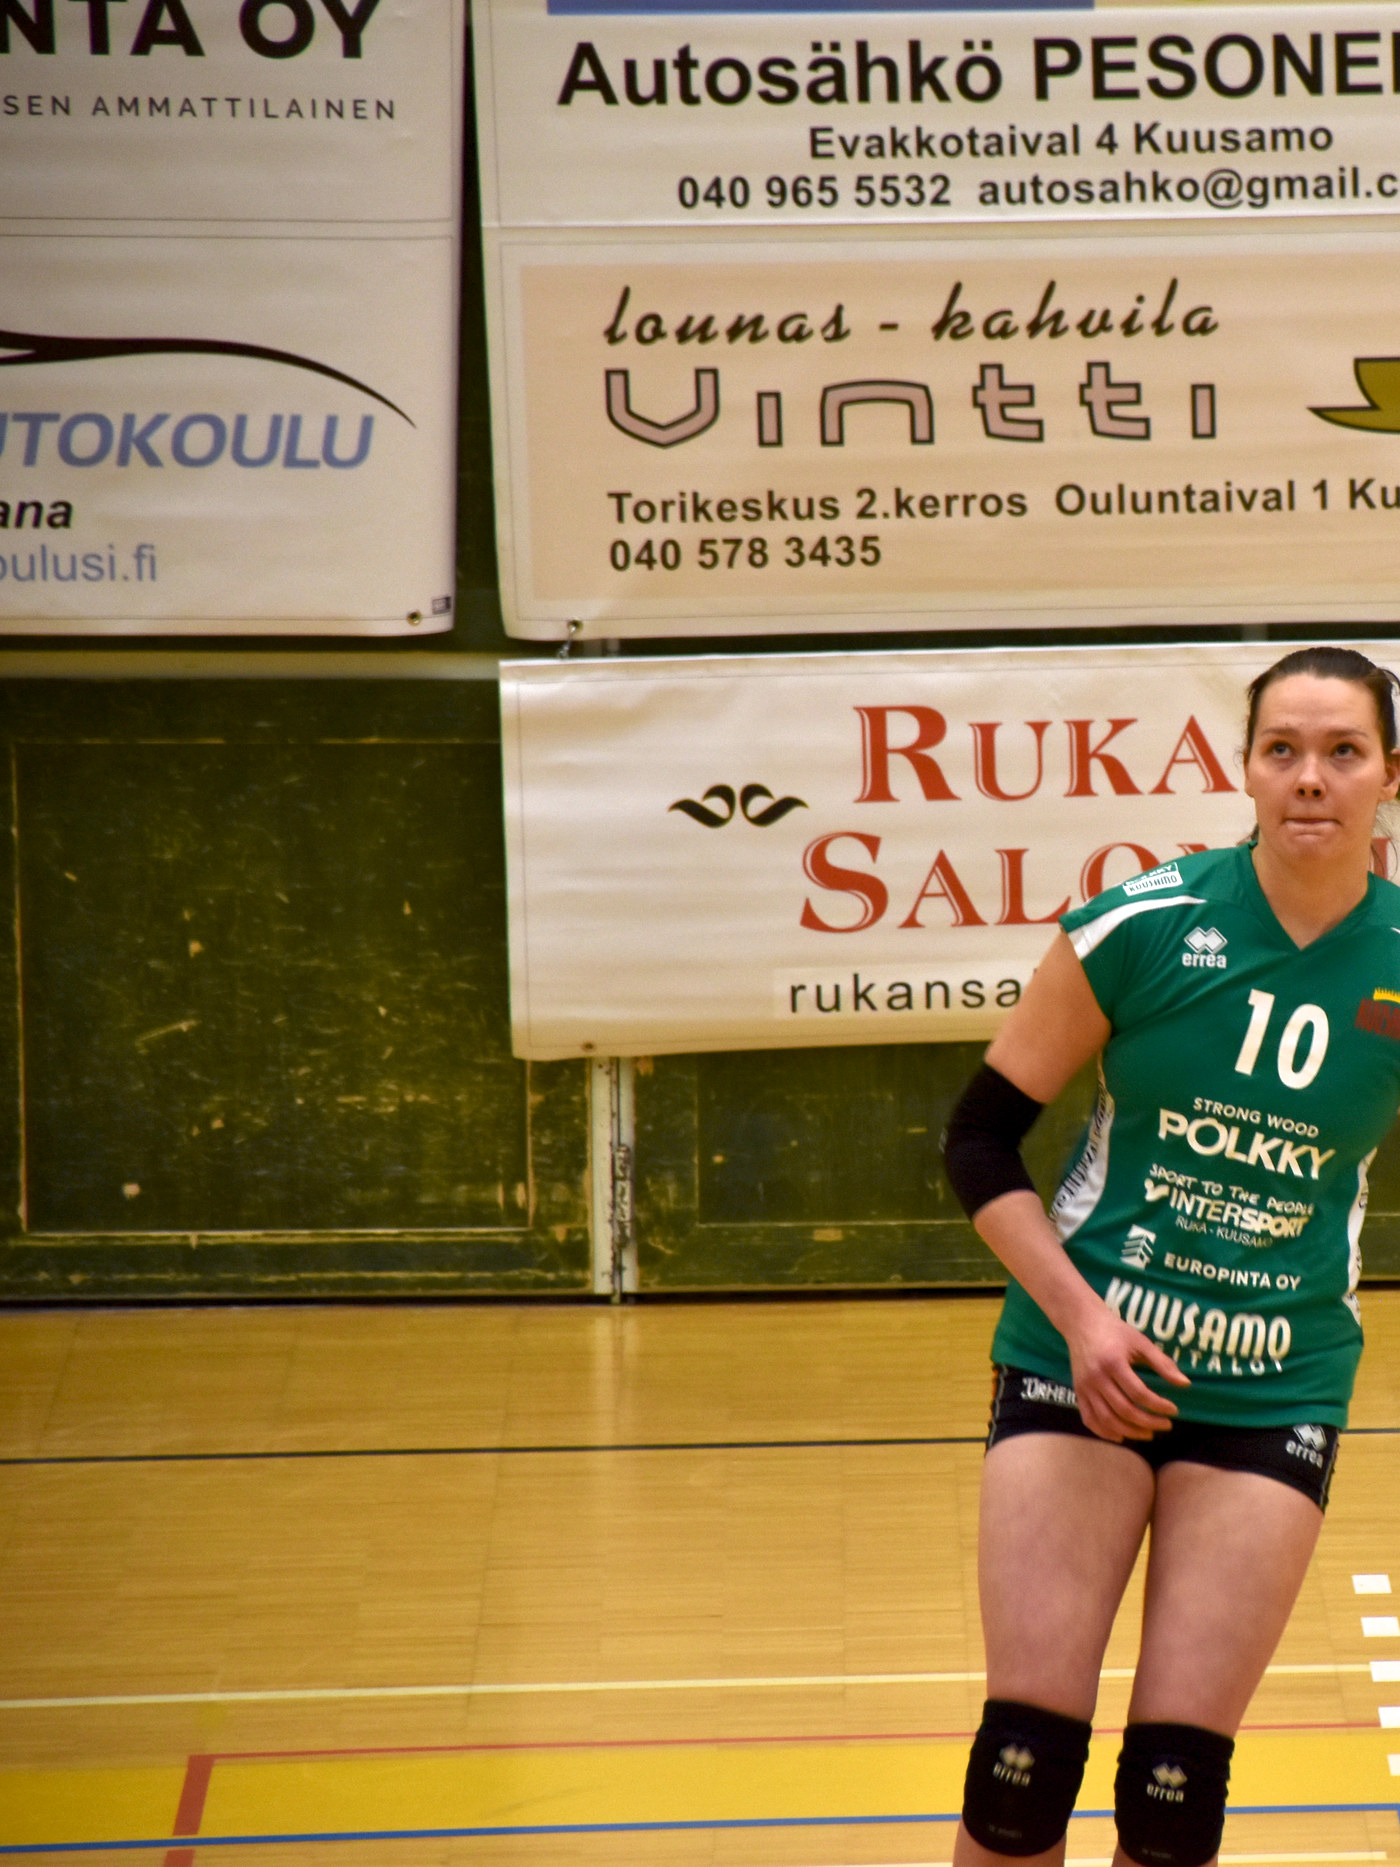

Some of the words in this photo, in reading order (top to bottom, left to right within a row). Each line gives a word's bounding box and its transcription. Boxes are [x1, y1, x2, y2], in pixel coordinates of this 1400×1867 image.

[239, 0, 379, 59] OY
[558, 39, 1003, 105] Autosähkö
[92, 97, 396, 119] AMMATTILAINEN
[810, 125, 1080, 159] Evakkotaival
[1096, 124, 1118, 154] 4
[1134, 122, 1333, 155] Kuusamo
[678, 177, 750, 208] 040
[766, 176, 839, 207] 965
[855, 175, 951, 206] 5532
[604, 286, 850, 345] lounas
[933, 280, 1218, 341] kahvila
[0, 412, 374, 469] TOKOULU
[607, 490, 840, 523] Torikeskus
[856, 487, 1028, 519] 2.kerros
[1055, 481, 1296, 515] Ouluntaival
[1313, 480, 1329, 509] 1
[611, 539, 681, 571] 040
[698, 538, 769, 569] 578
[784, 536, 881, 567] 3435
[1235, 988, 1329, 1090] 10
[1193, 1097, 1262, 1125] STRONG
[1267, 1113, 1320, 1138] WOOD
[1150, 1163, 1198, 1190] SPORT
[1201, 1180, 1224, 1197] TO
[1229, 1185, 1261, 1206] THE
[1169, 1186, 1311, 1239] INTERSPORT
[1164, 1251, 1272, 1289] EUROPINTA
[1275, 1273, 1302, 1292] OY
[1104, 1276, 1292, 1361] KUUSAMO
